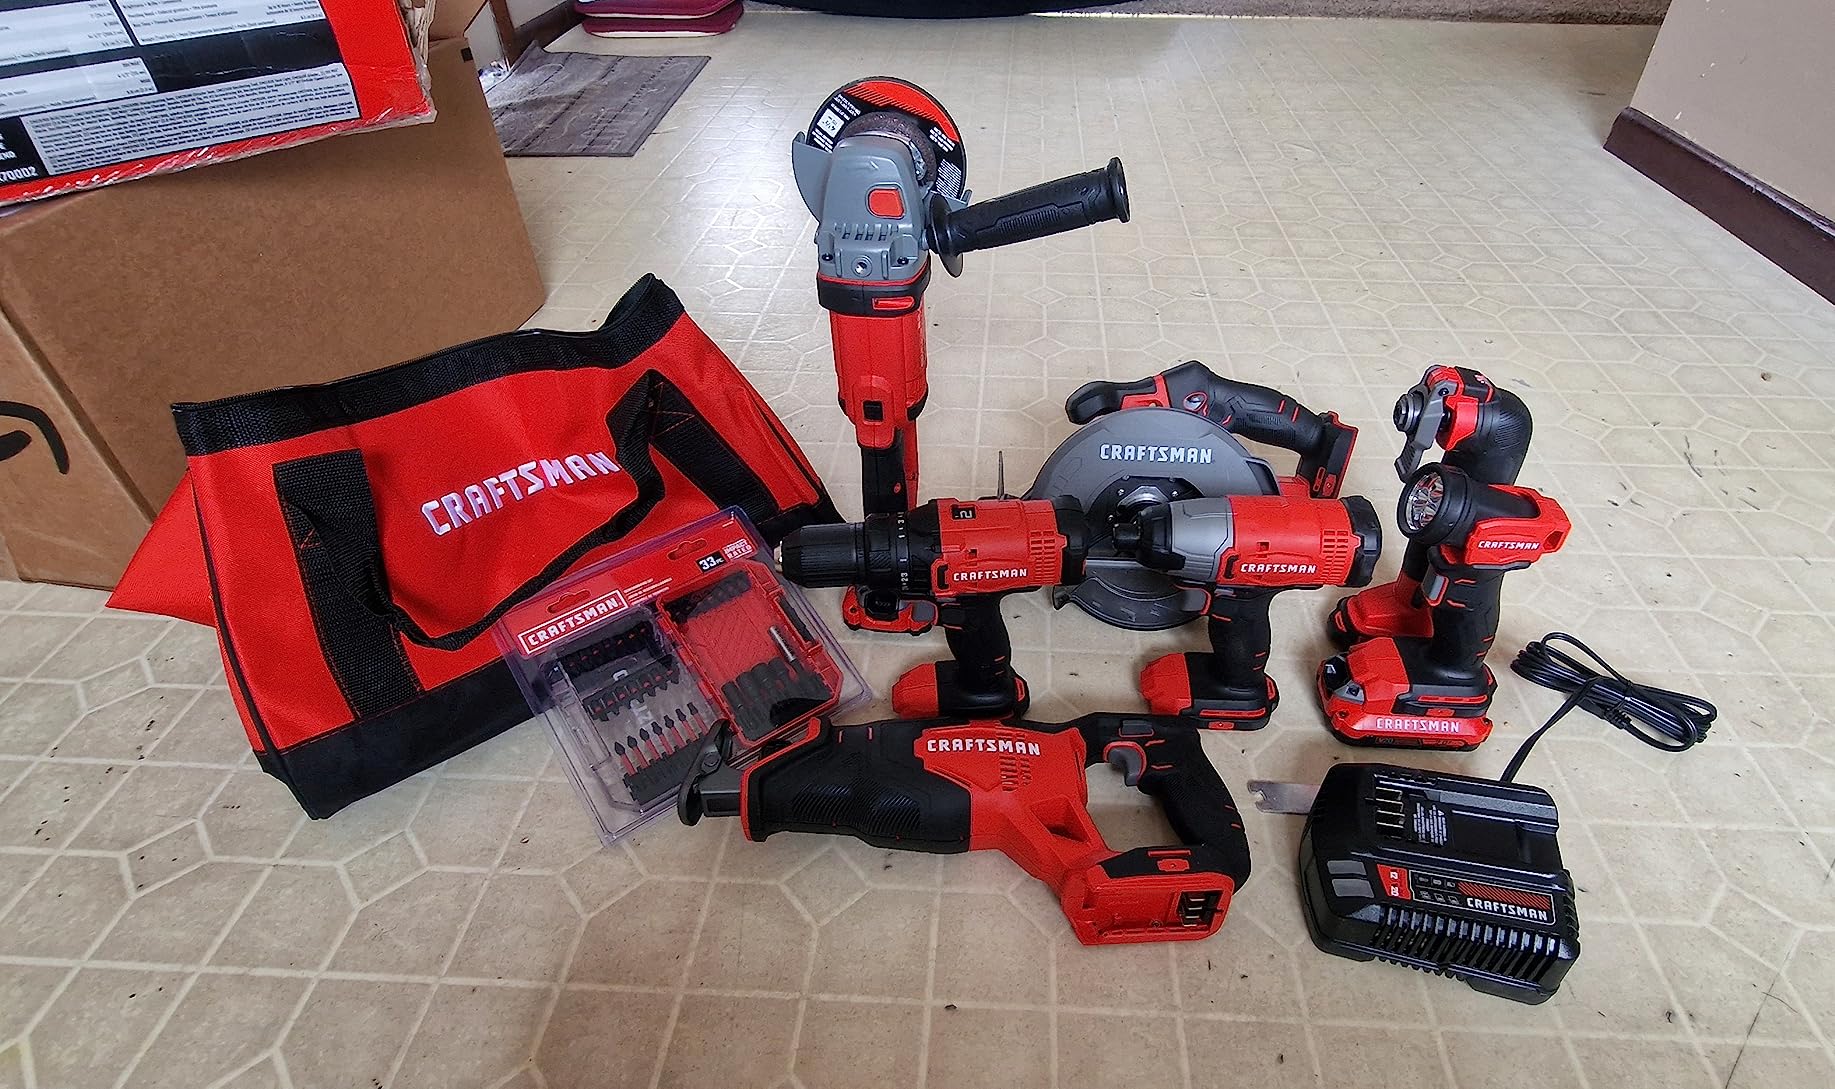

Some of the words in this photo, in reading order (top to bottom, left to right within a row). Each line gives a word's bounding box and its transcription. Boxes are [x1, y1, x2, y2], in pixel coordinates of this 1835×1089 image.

[1100, 443, 1212, 464] CRAFTSMAN
[421, 451, 621, 536] CRAFTSMAN
[726, 544, 753, 560] RATED
[1478, 540, 1540, 550] CRAFTSMAN
[953, 567, 1028, 581] CRAFTSMAN
[1240, 563, 1317, 574] CRAFTSMAN
[527, 597, 619, 646] CRAFTSMAN
[1376, 717, 1460, 733] CRAFTSMAN
[927, 738, 1041, 755] CRAFTSMAN
[1466, 897, 1548, 921] CRAFTSMAN
